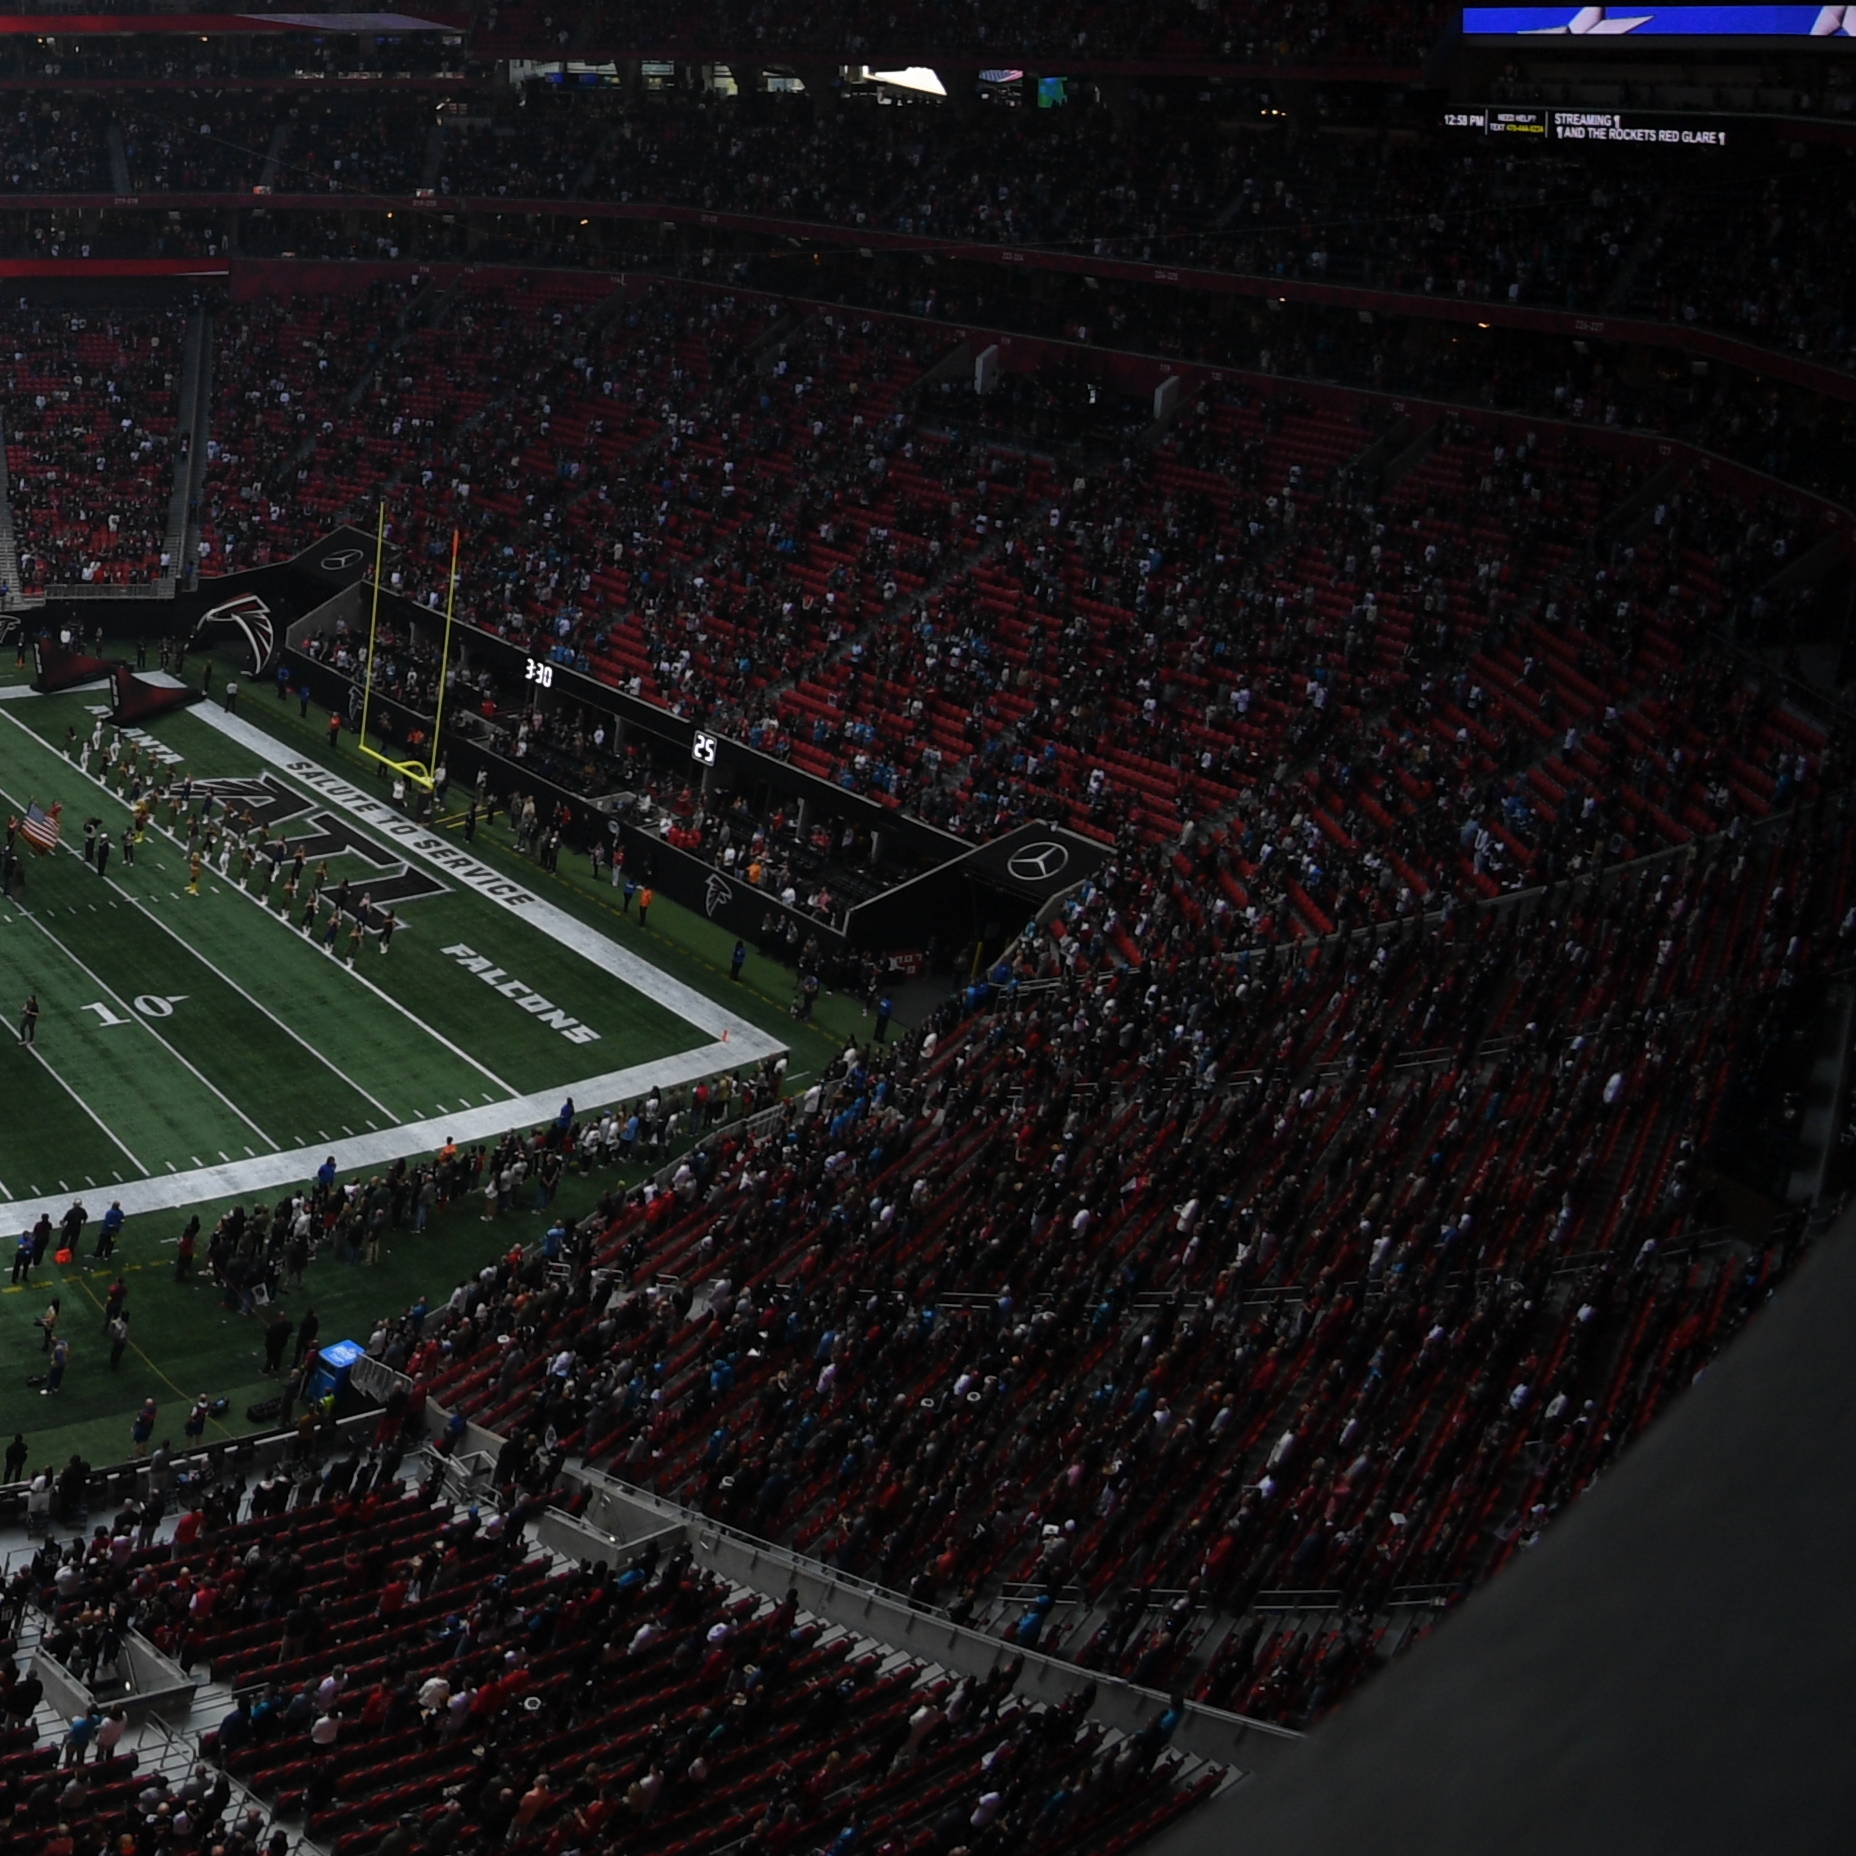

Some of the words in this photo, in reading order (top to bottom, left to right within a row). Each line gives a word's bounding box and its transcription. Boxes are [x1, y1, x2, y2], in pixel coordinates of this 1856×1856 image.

[1470, 115, 1484, 126] PM
[1554, 113, 1612, 127] STREAMING
[1563, 127, 1585, 139] AND
[1587, 128, 1607, 140] THE
[1608, 129, 1657, 142] ROCKETS
[1658, 129, 1679, 142] RED
[1681, 130, 1718, 144] GLARE
[524, 657, 553, 688] 3:30
[693, 733, 715, 762] 25
[285, 759, 383, 823] SALUTE
[375, 814, 418, 838] TO
[412, 834, 538, 909] SERVICE
[438, 941, 602, 1048] FALCONS
[79, 993, 175, 1028] 10
